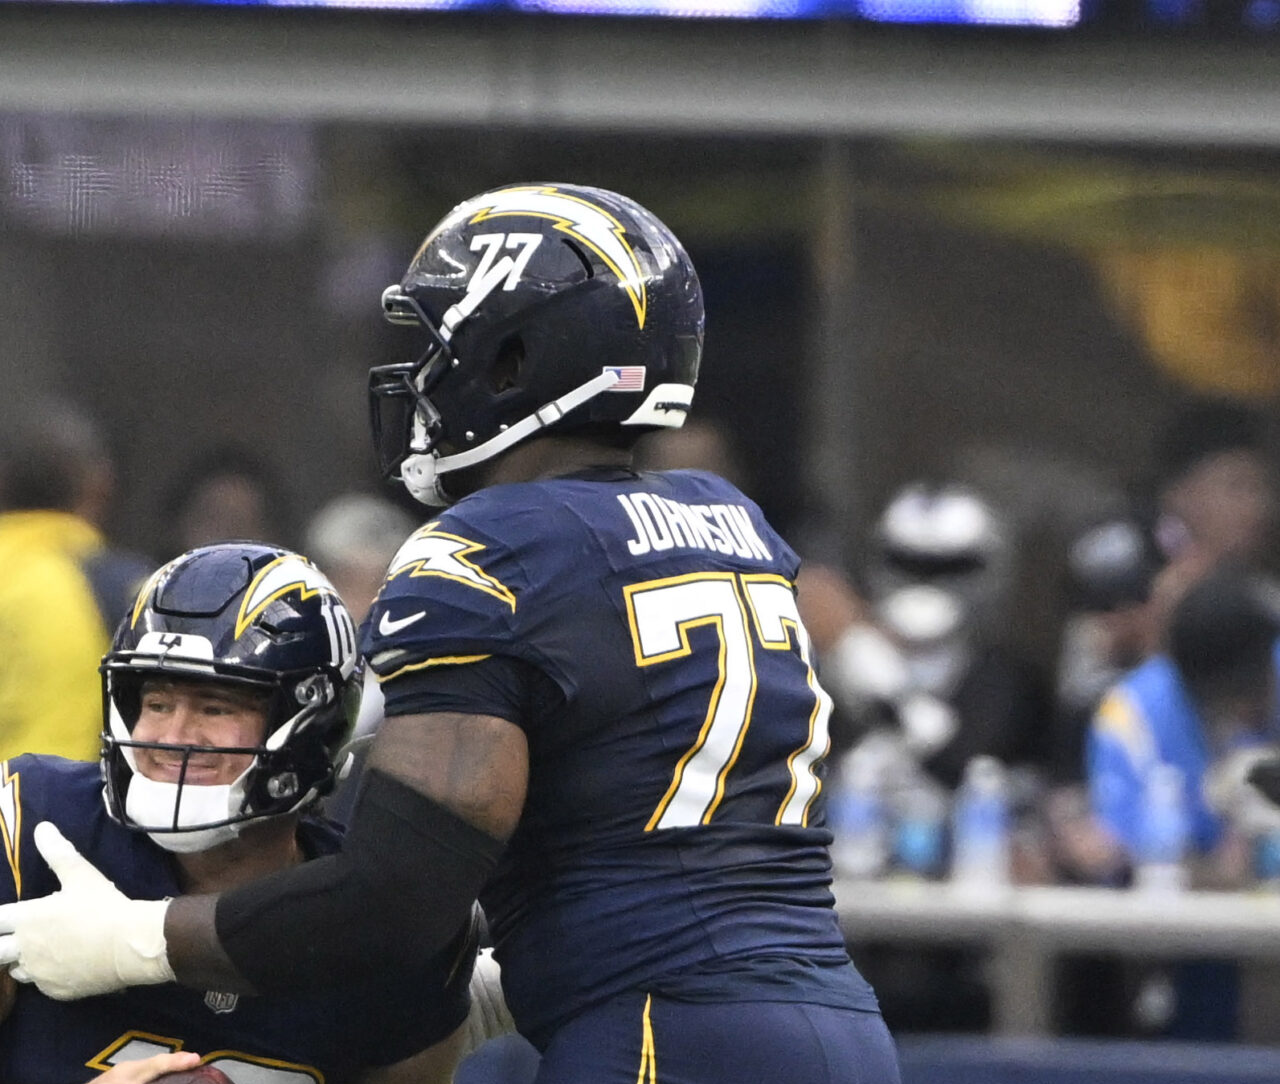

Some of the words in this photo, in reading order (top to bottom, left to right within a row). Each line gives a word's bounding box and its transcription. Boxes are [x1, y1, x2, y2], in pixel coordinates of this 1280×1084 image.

[466, 233, 543, 292] 77
[616, 492, 773, 561] JOHNSON
[320, 593, 357, 668] 10
[622, 571, 834, 832] 77
